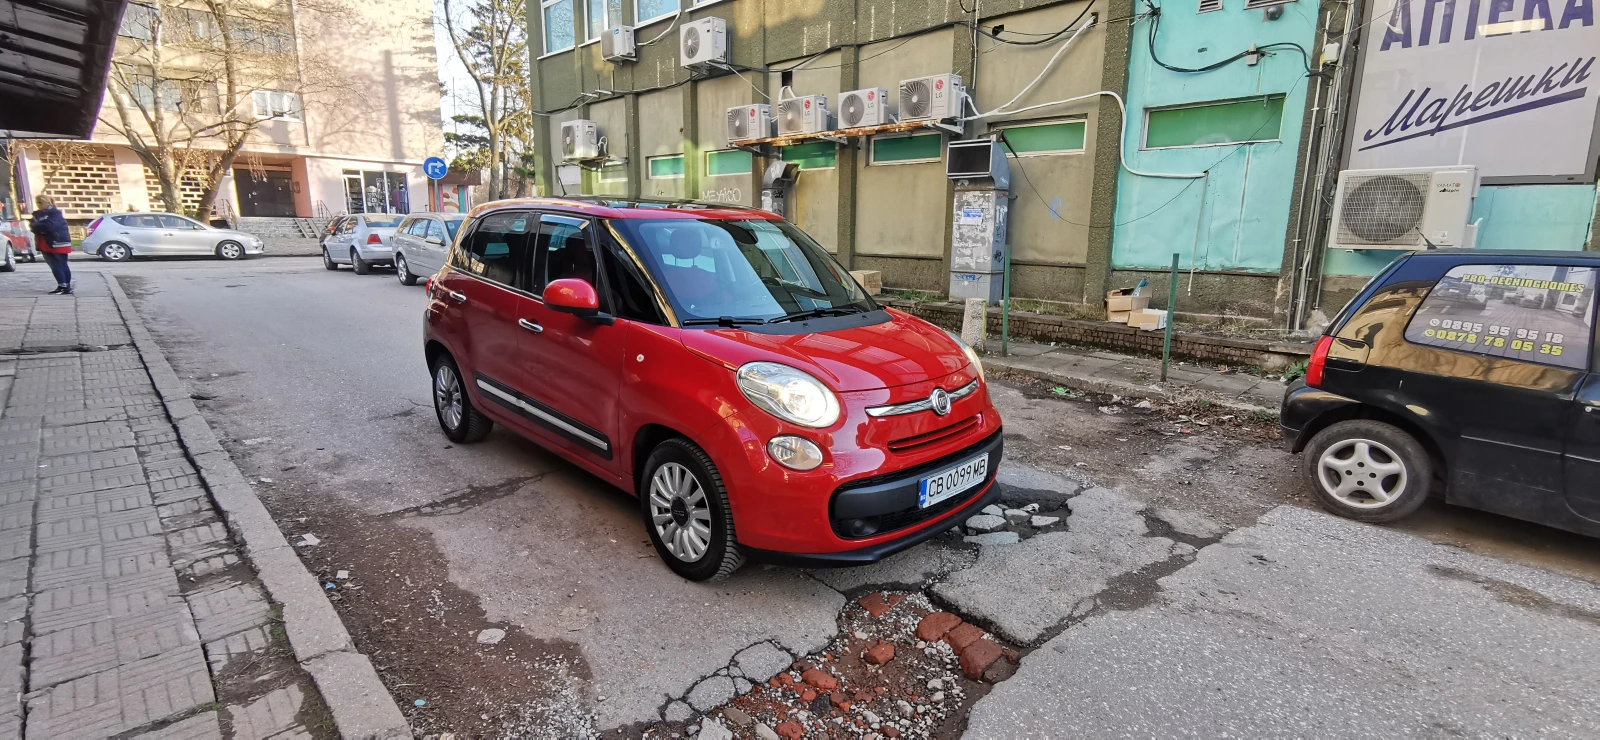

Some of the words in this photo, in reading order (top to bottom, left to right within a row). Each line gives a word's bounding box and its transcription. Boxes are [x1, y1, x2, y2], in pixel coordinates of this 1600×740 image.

[1363, 56, 1596, 141] Марешки
[1436, 330, 1478, 344] 0878
[1483, 336, 1505, 348] 78
[1511, 340, 1534, 352] 05
[1539, 344, 1563, 356] 35
[1441, 319, 1483, 333] 0895
[1488, 325, 1511, 337] 95
[1516, 329, 1539, 341] 95
[1544, 332, 1564, 344] 18
[928, 479, 943, 497] CB
[946, 465, 971, 491] 0099
[973, 458, 986, 479] MB
